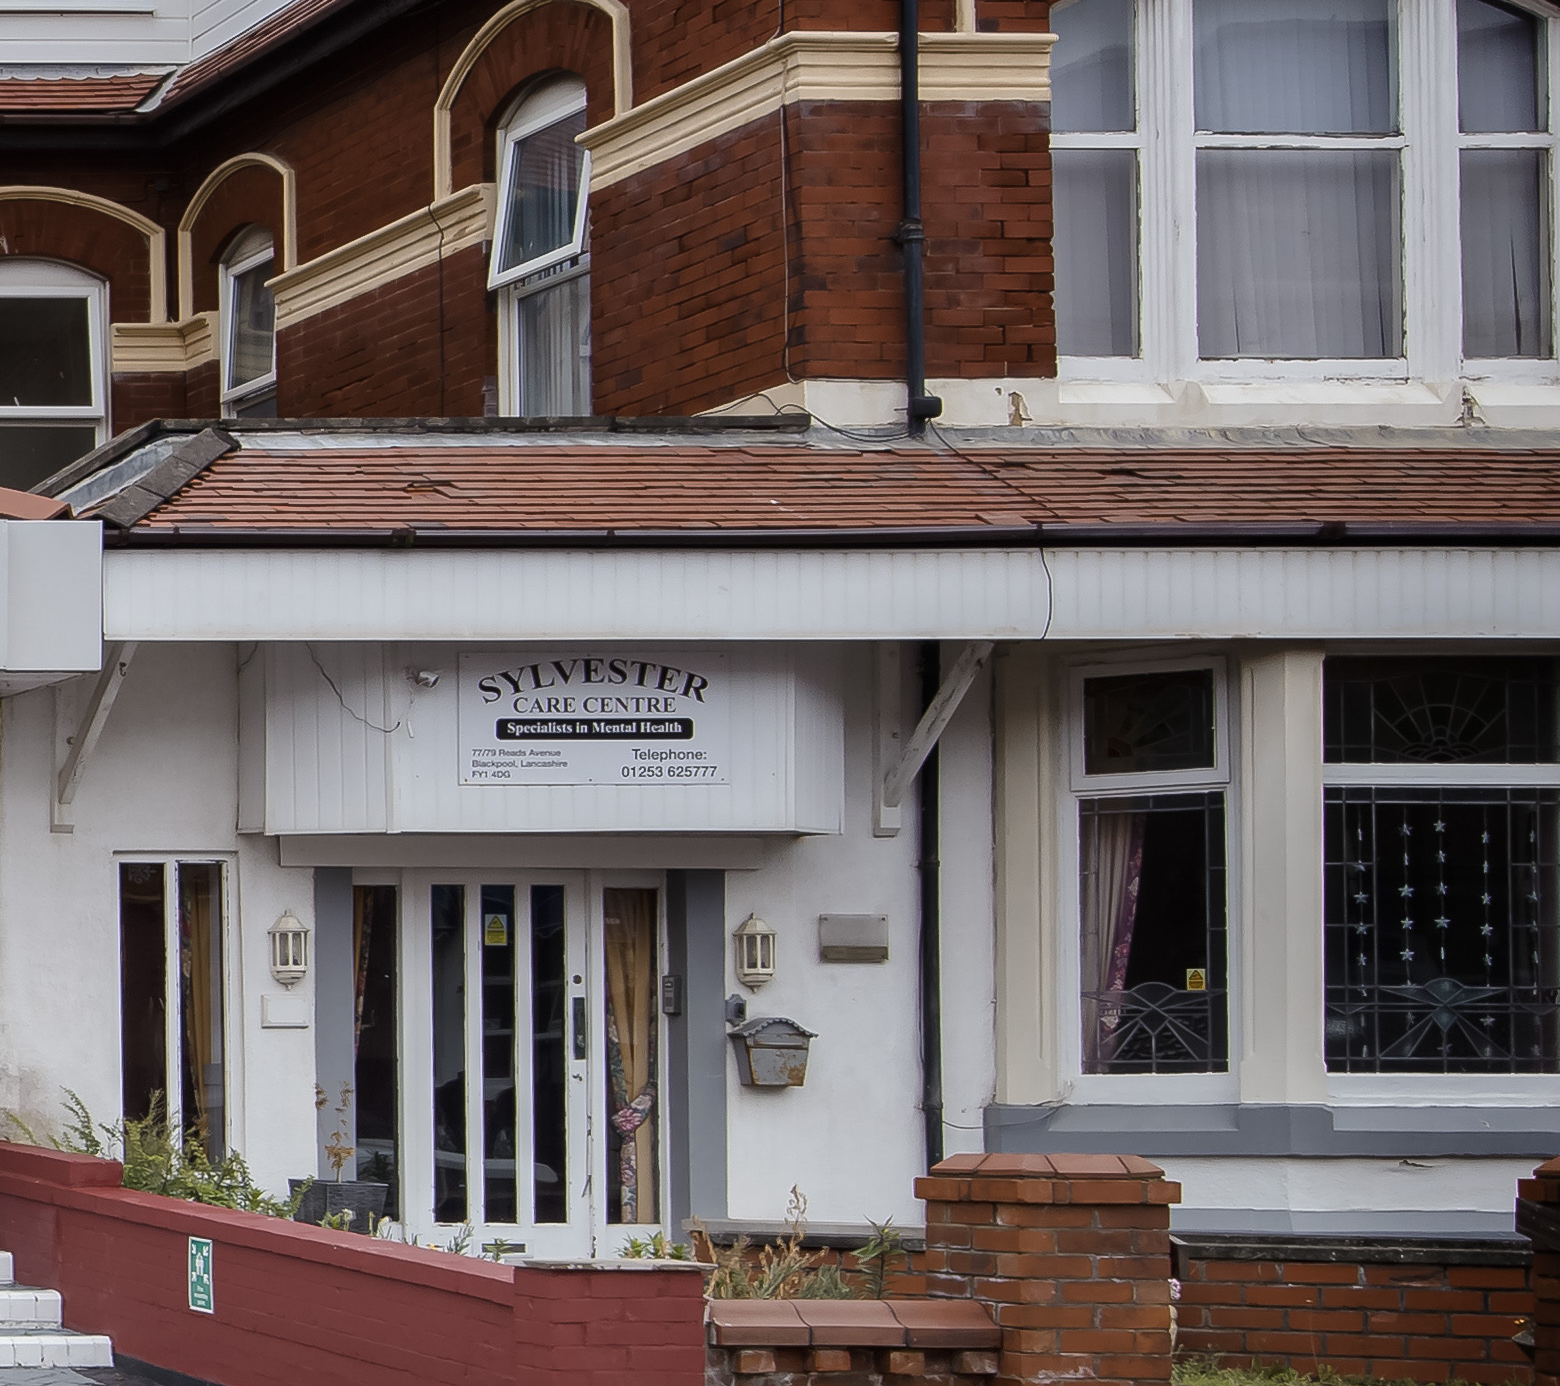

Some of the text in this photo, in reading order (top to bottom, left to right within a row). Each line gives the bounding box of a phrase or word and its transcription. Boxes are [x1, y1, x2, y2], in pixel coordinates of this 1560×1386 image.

[478, 657, 709, 704] SYLVESTER
[513, 697, 677, 714] CARE CENTRE
[507, 722, 682, 735] Specialists in Mental Health
[498, 749, 527, 757] Reads
[528, 749, 562, 757] Avenue
[632, 749, 707, 762] Telephone:
[472, 760, 568, 770] Blackpool, Lancashire
[621, 766, 718, 778] 01253 625777
